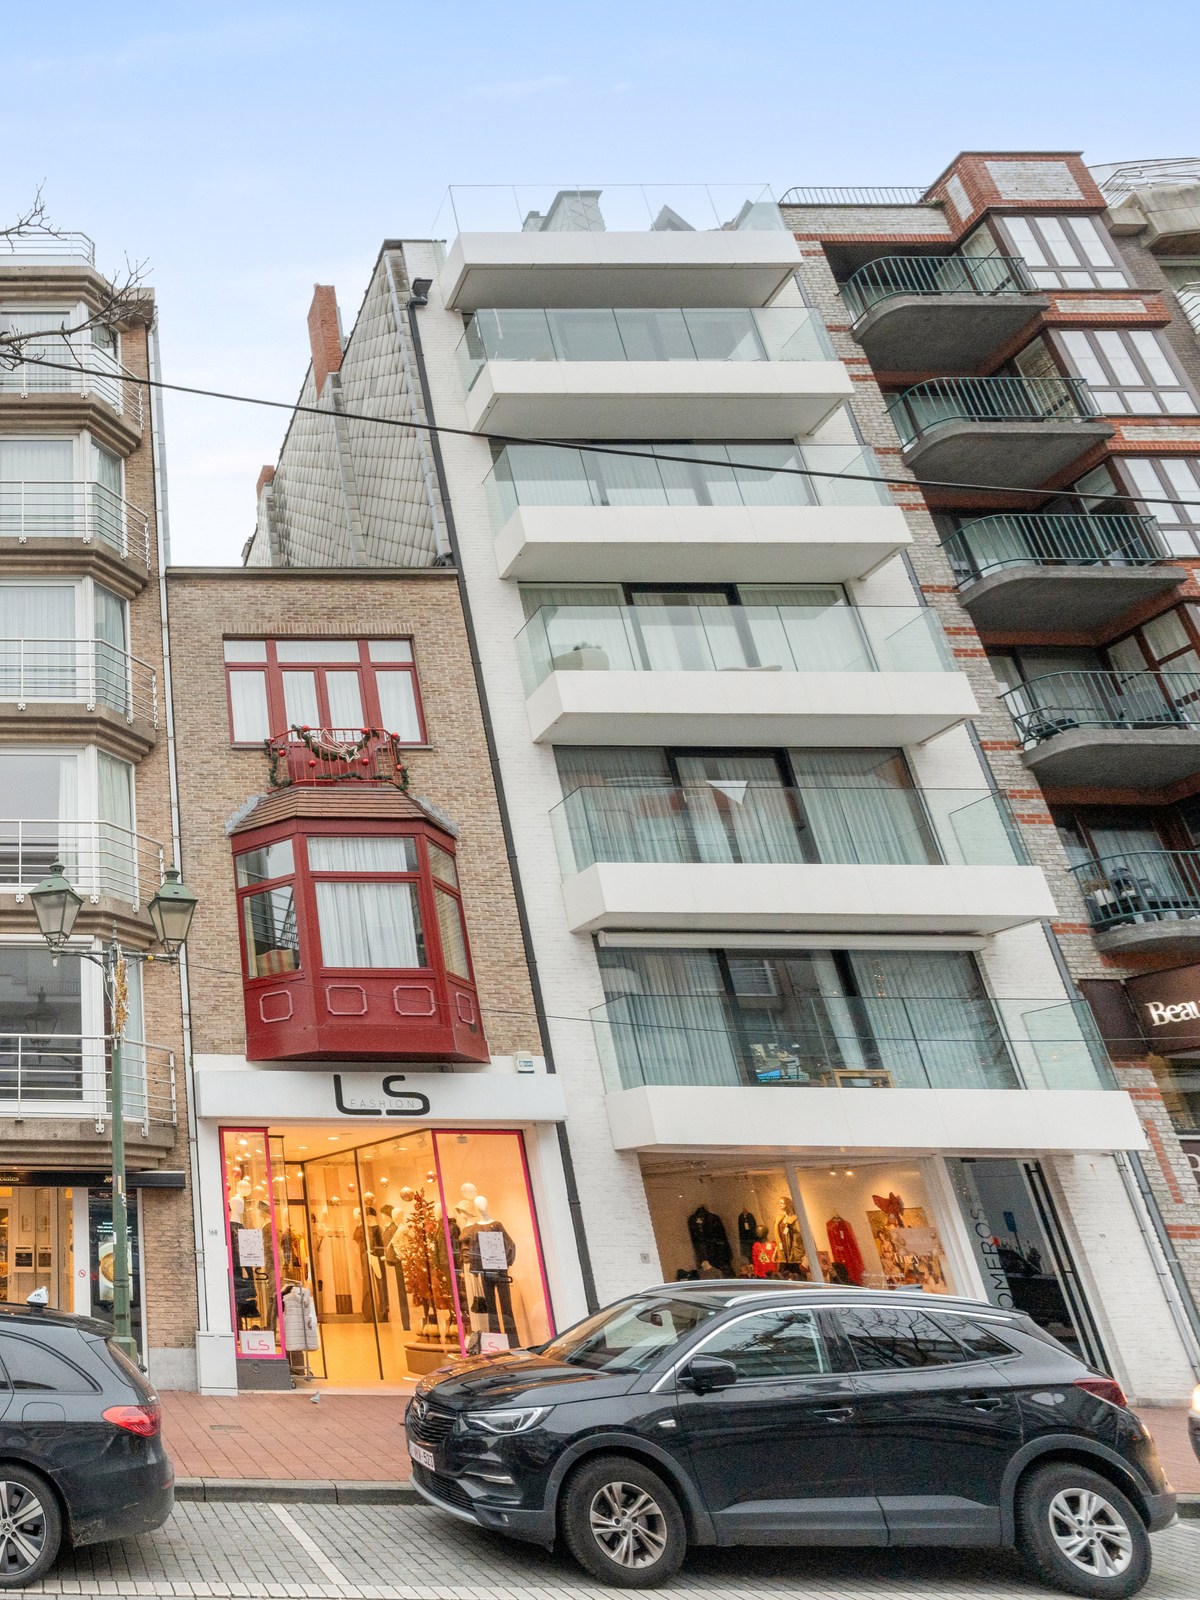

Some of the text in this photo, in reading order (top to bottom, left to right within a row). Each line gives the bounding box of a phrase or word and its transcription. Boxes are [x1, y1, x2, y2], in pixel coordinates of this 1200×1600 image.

[333, 1074, 431, 1116] LS
[350, 1099, 416, 1109] FASHION
[247, 1339, 270, 1351] LS
